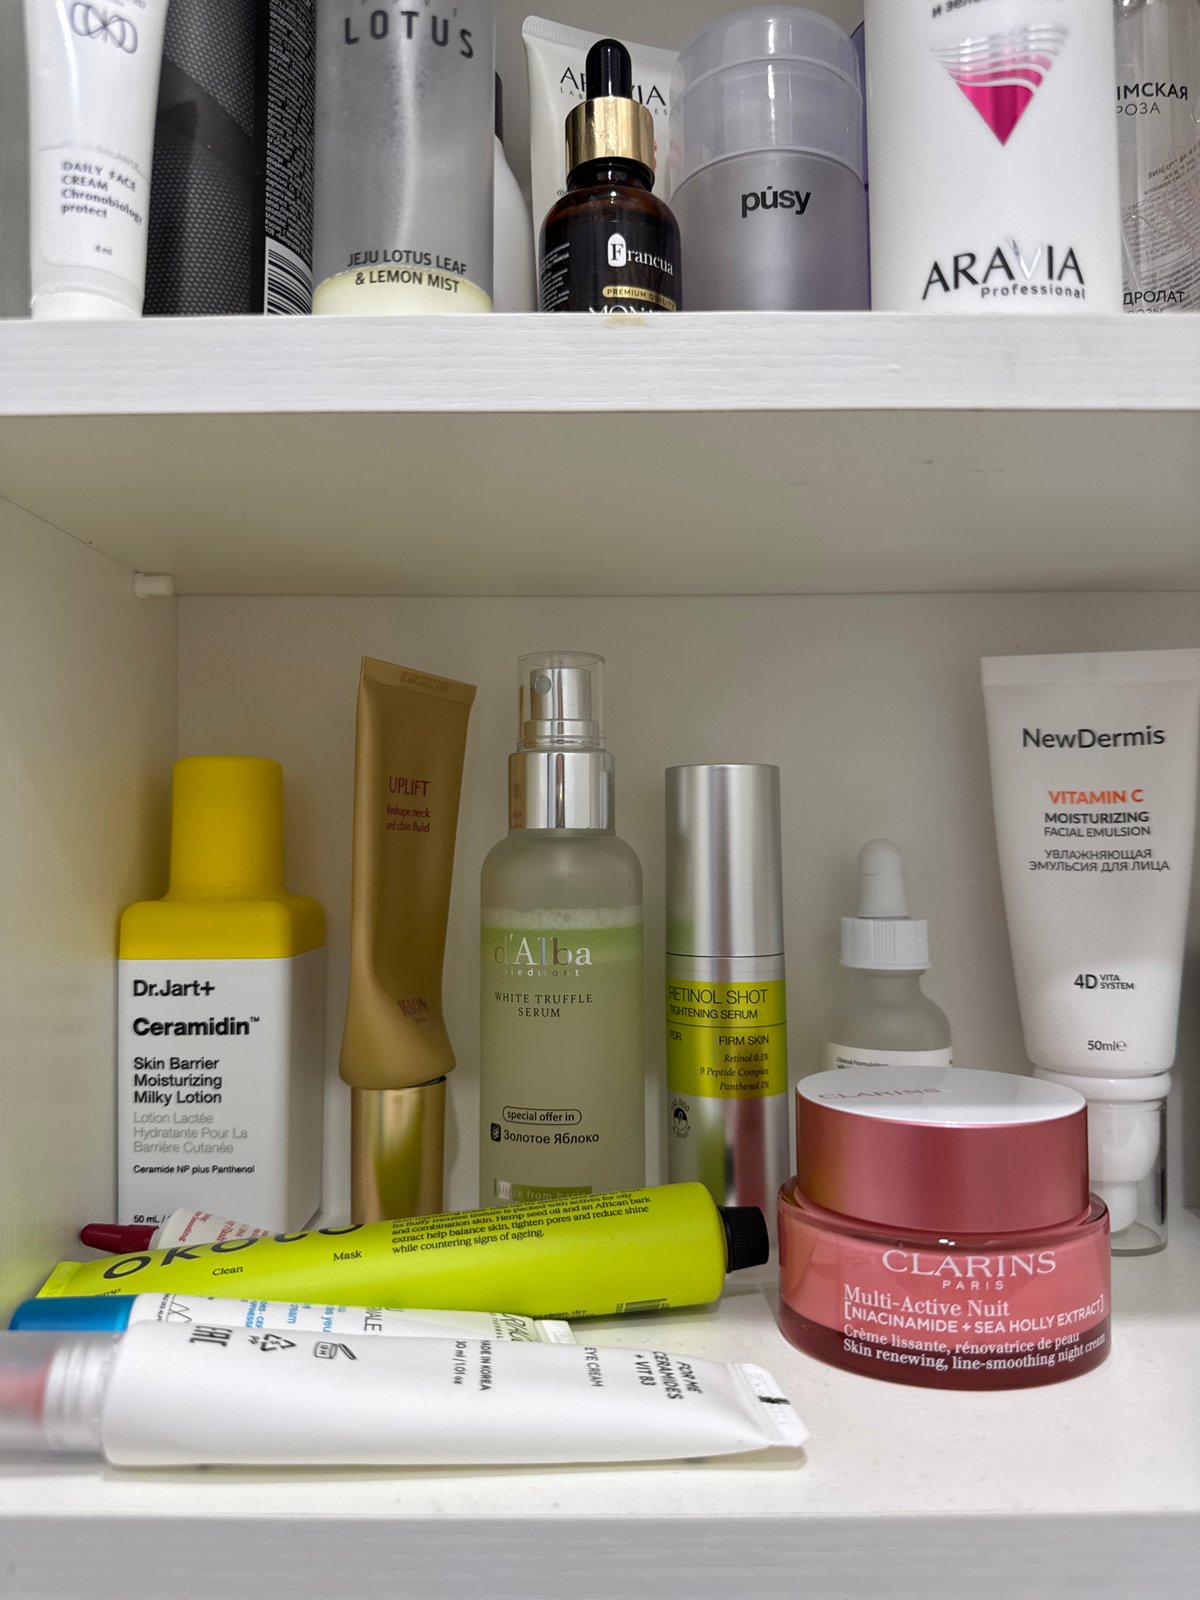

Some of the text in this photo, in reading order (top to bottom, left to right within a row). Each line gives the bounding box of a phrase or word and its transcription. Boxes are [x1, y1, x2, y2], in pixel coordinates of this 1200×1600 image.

[344, 10, 474, 59] LOTUS
[62, 175, 108, 191] CREAM
[63, 161, 136, 191] DAILY FACE
[62, 189, 143, 225] Chronobiology
[741, 186, 811, 218] púsy
[62, 204, 107, 218] protect
[348, 249, 468, 276] JEJU LOTUS LEAF
[608, 240, 674, 277] Francua
[921, 237, 1085, 300] ARAVIA
[355, 269, 460, 294] & LEMON MIST
[607, 288, 647, 299] PREMIUM
[1022, 725, 1165, 748] NewDermis
[389, 776, 430, 797] UPLIFT
[1048, 789, 1144, 804] VITAMIN C
[412, 806, 431, 818] neck
[1045, 811, 1149, 824] MOISTURIZING
[386, 821, 430, 833] and chin fluid
[1044, 826, 1151, 837] FACIAL EMULSION
[1044, 849, 1152, 861] УВЛАЖНЯЮЩАЯ
[1029, 860, 1170, 873] ЭМУЛЬСИЯ ДЛЯ ЛИЦА
[495, 934, 593, 966] d'Alba
[133, 979, 216, 997] Dr.Jart+
[1074, 973, 1098, 989] 4D
[1100, 982, 1134, 990] SYSTEM
[494, 991, 593, 1005] WHITE TRUFFLE
[668, 985, 768, 1005] RETINOL SHOT
[518, 1007, 561, 1018] SERUM
[669, 1004, 758, 1020] TIGHTENING SERUM
[669, 1029, 769, 1046] FOR FIRM SKIN
[133, 1057, 219, 1070] Skin Barrier
[724, 1054, 752, 1063] Retinol
[700, 1067, 769, 1078] 9 Peptide Complex
[133, 1074, 223, 1089] Moisturizing
[719, 1081, 760, 1091] Panthenol
[133, 1090, 222, 1107] Milky Lotion
[819, 1088, 941, 1099] CLARINS
[133, 1111, 213, 1124] Lotion Lactée
[507, 1110, 575, 1122] special offer in
[133, 1127, 248, 1140] Hydratante Pour La
[503, 1129, 599, 1144] Золотое Яблоко
[133, 1141, 234, 1154] Barrière Cutanée
[133, 1165, 255, 1175] Ceramide NP plus Panthenol
[513, 1203, 546, 1213] packed
[569, 1197, 600, 1205] actives
[133, 1214, 160, 1223] 50 mL
[411, 1220, 471, 1233] combination
[471, 1217, 493, 1225] skin.
[496, 1211, 524, 1221] Hemp
[549, 1208, 561, 1216] oil
[595, 1200, 629, 1209] African
[630, 1197, 652, 1205] bark
[391, 1205, 649, 1244] extract help balance skin, tighten pores and reduce shine
[392, 1243, 419, 1253] while
[420, 1238, 472, 1251] countering
[473, 1234, 498, 1245] signs
[499, 1231, 509, 1240] of
[333, 1249, 363, 1262] Mask
[212, 1264, 244, 1276] Clean
[882, 1249, 1057, 1279] CLARINS
[942, 1279, 1004, 1290] PARIS
[843, 1284, 1010, 1318] Multi-Active Nuit
[843, 1296, 1104, 1334] [NIACINAMIDE + SEA HOLLY EXTRACT]
[843, 1324, 1080, 1356] Crème lissante, rénovatrice de peau
[455, 1349, 467, 1358] ml
[480, 1356, 492, 1364] IN
[843, 1333, 1106, 1371] Skin renewing, line-smoothing night cream
[584, 1346, 605, 1387] EYE CREAM
[634, 1361, 657, 1386] VIT B3
[454, 1375, 463, 1385] oz
[479, 1364, 492, 1391] KOREA
[652, 1350, 684, 1400] CERAMIDES
[676, 1360, 704, 1394] FOR ME
